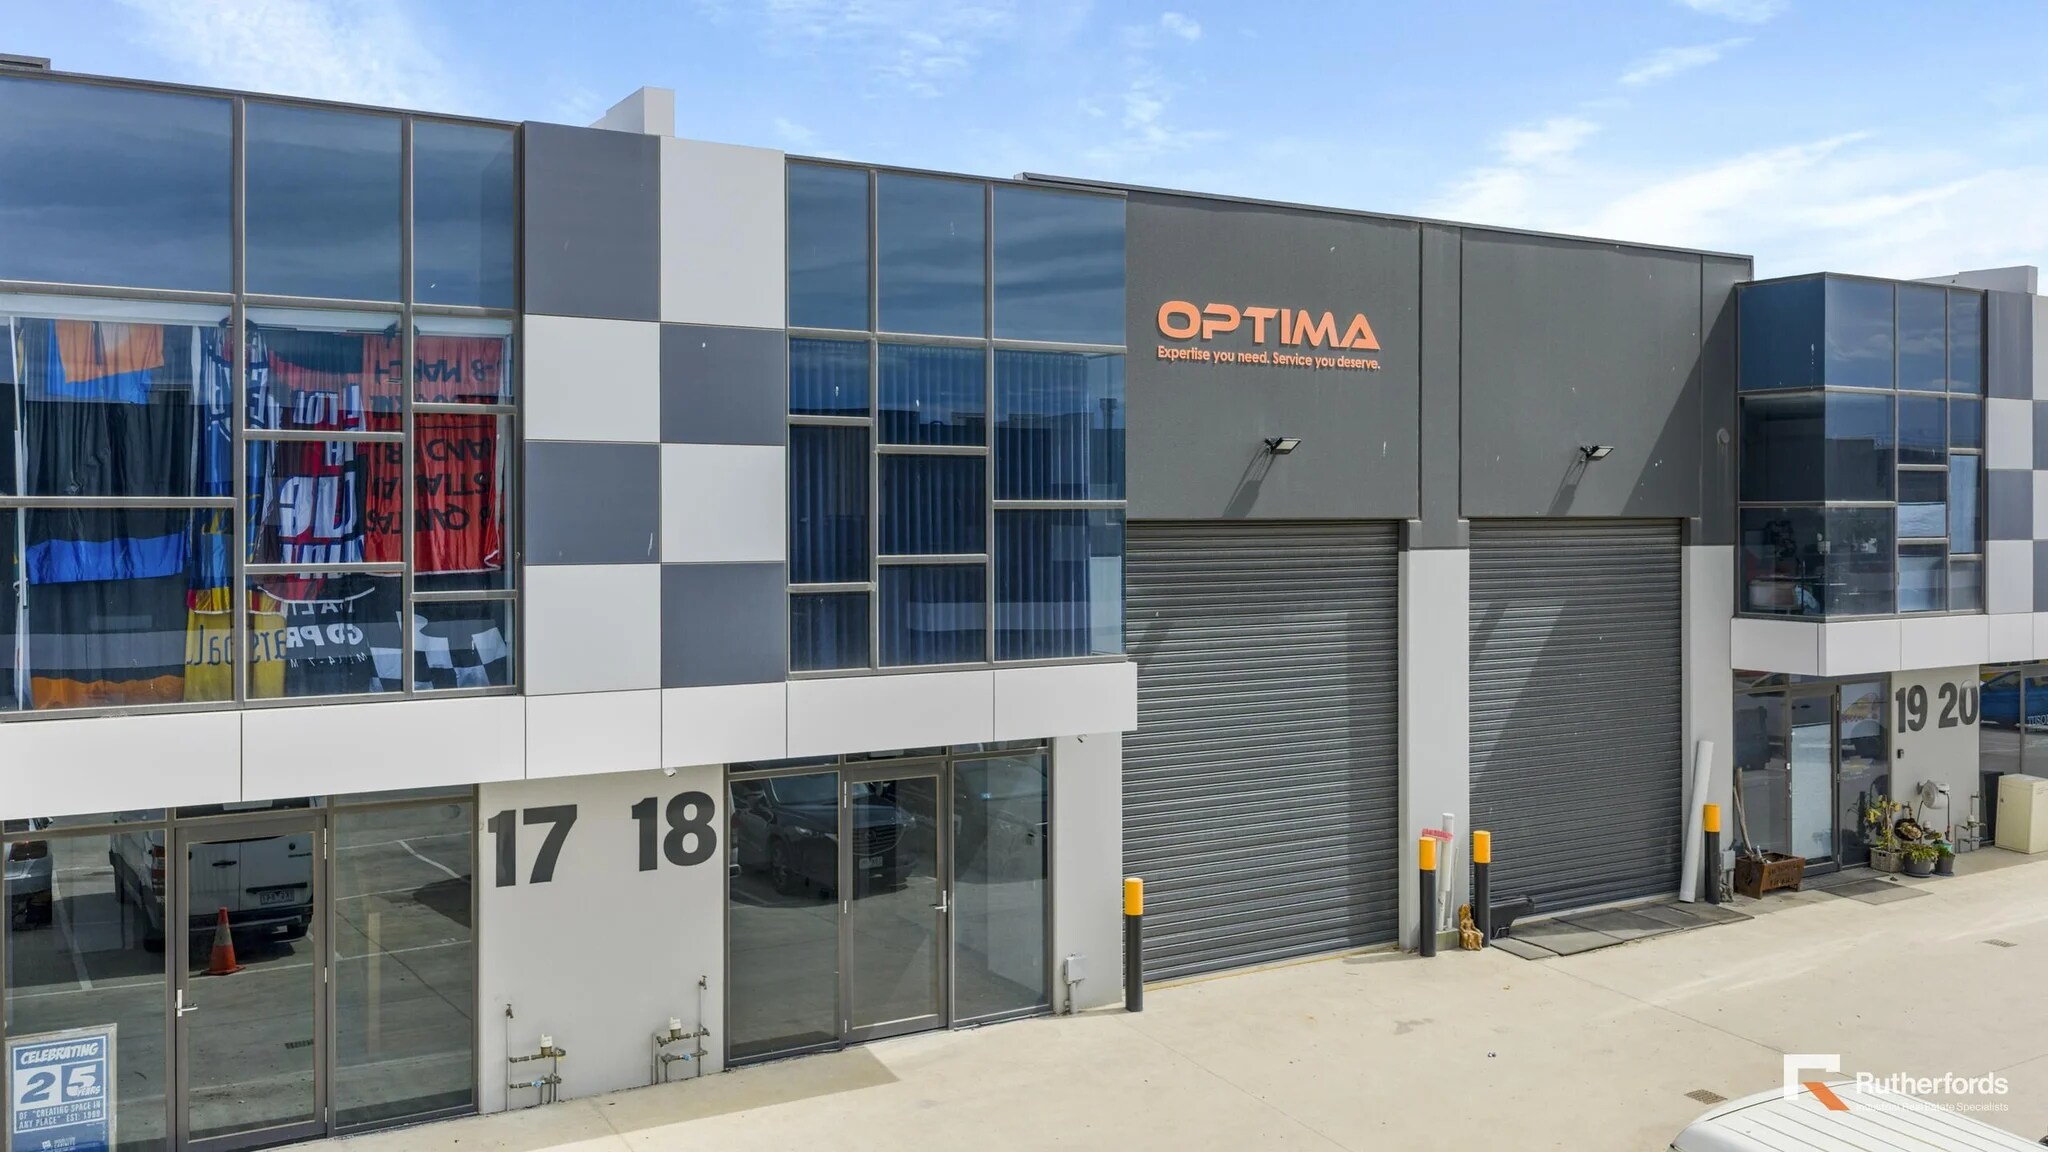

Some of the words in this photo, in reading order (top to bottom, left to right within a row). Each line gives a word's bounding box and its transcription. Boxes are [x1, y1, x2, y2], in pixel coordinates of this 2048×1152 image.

[1158, 301, 1380, 350] OPTIMA
[1158, 345, 1210, 362] Expertise
[1214, 350, 1235, 364] you
[1238, 352, 1270, 365] need.
[1273, 352, 1312, 367] Service
[1315, 357, 1335, 370] you
[1337, 355, 1381, 370] deserve.
[1895, 685, 1928, 733] 19
[1938, 681, 1978, 729] 20
[2028, 714, 2048, 727] TUSO
[488, 804, 577, 887] 17
[632, 791, 717, 872] 18
[20, 1043, 98, 1065] CELEBRATING
[20, 1064, 97, 1104] 25
[19, 1111, 28, 1121] OF
[71, 1103, 91, 1113] SPACE
[19, 1120, 34, 1130] ANY
